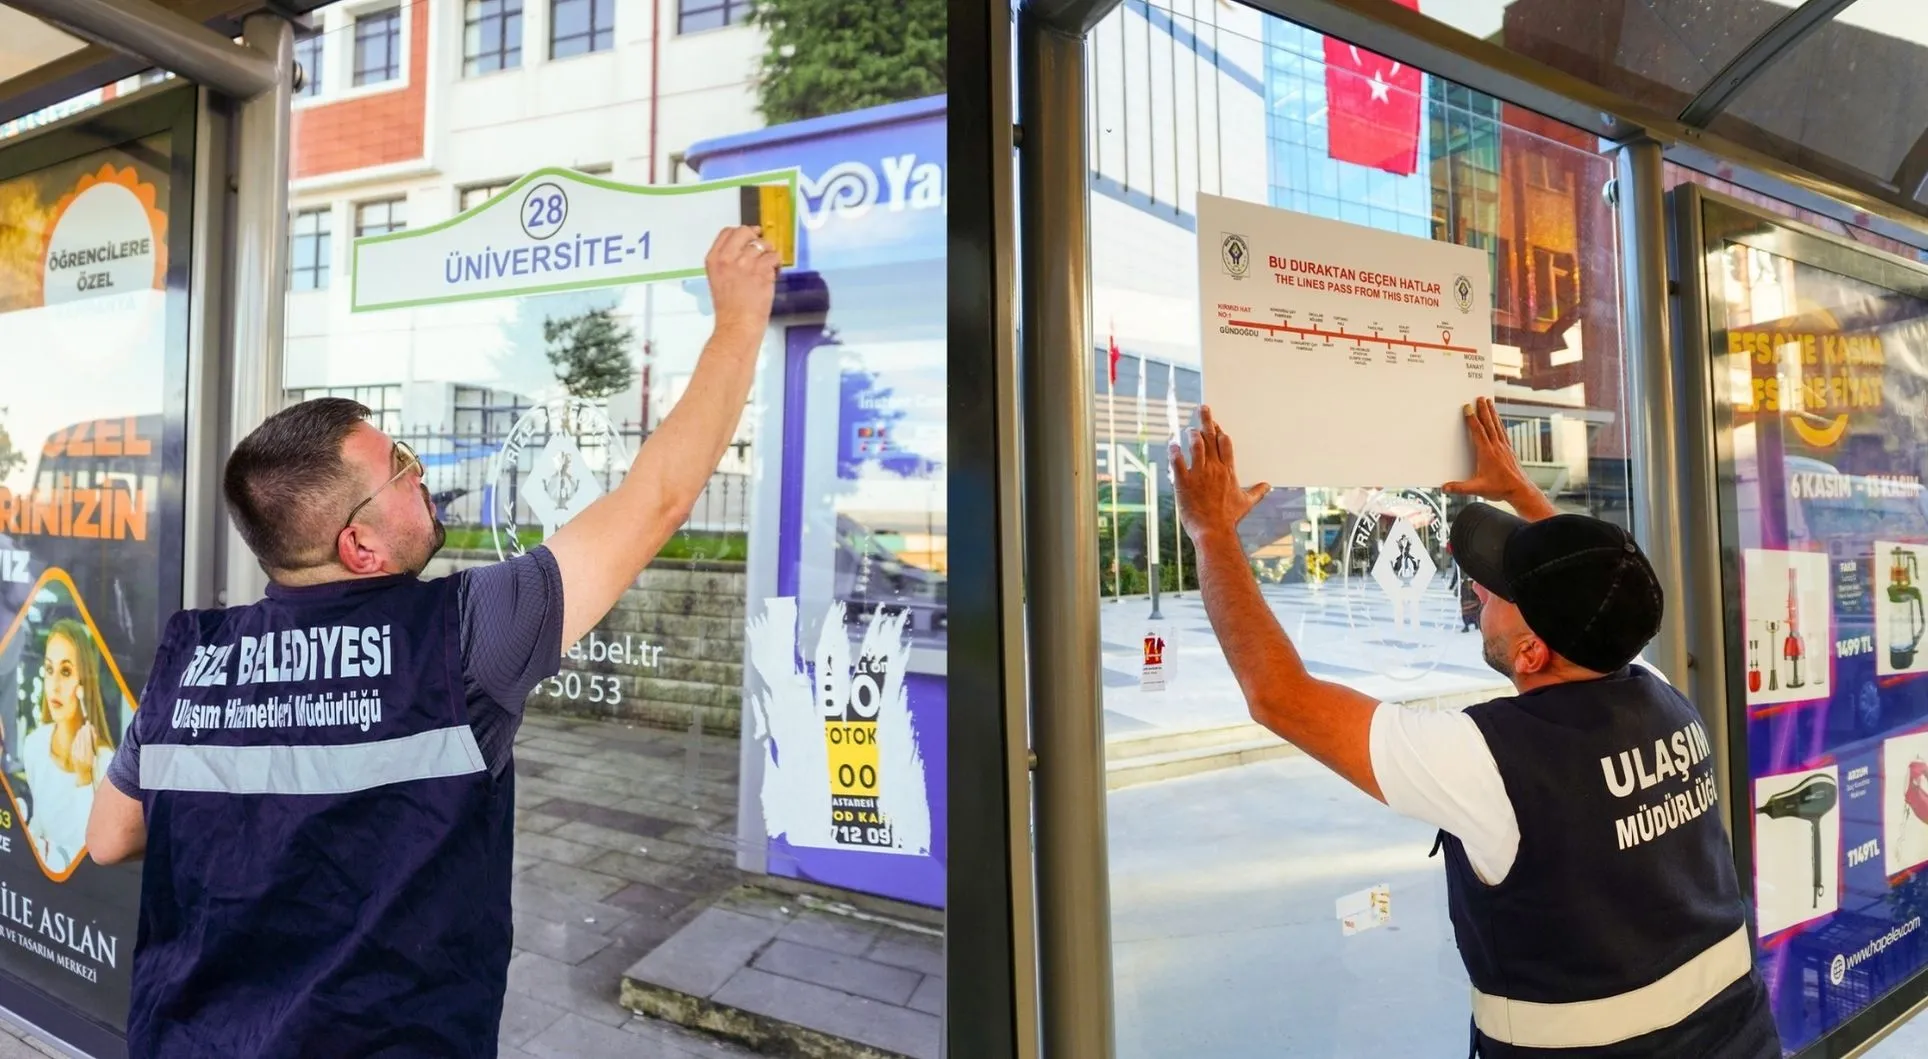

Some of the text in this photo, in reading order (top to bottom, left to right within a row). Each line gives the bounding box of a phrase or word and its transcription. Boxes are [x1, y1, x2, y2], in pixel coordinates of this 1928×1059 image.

[527, 194, 563, 228] 28
[49, 238, 150, 272] ÖĞRENCİLERE
[445, 230, 652, 284] ÜNİVERSİTE-1
[1269, 255, 1287, 270] BU
[1290, 259, 1356, 282] DURAKTAN
[1358, 270, 1397, 288] GEÇEN
[1399, 277, 1441, 295] HATLAR
[77, 270, 114, 292] ÖZEL
[1275, 273, 1295, 287] THE
[1327, 282, 1353, 295] PASS
[1354, 287, 1381, 299] FROM
[1382, 290, 1402, 303] THIS
[1403, 294, 1440, 308] STATION
[1219, 325, 1259, 338] GÜNDOĞDU
[1791, 474, 1801, 499] 6
[1802, 473, 1853, 499] KASIM
[236, 624, 393, 687] BELEDİYESİ
[588, 675, 622, 705] 53
[171, 689, 383, 738] Ulaşım Hizmetleri Müdürlüğü
[1600, 719, 1711, 799] ULAŞIM
[5, 927, 17, 943] VE
[17, 933, 55, 963] TASARIM
[56, 954, 97, 984] MERKEZİ
[38, 906, 118, 969] ASLAN
[1846, 916, 1921, 970] www.hapelev.com
